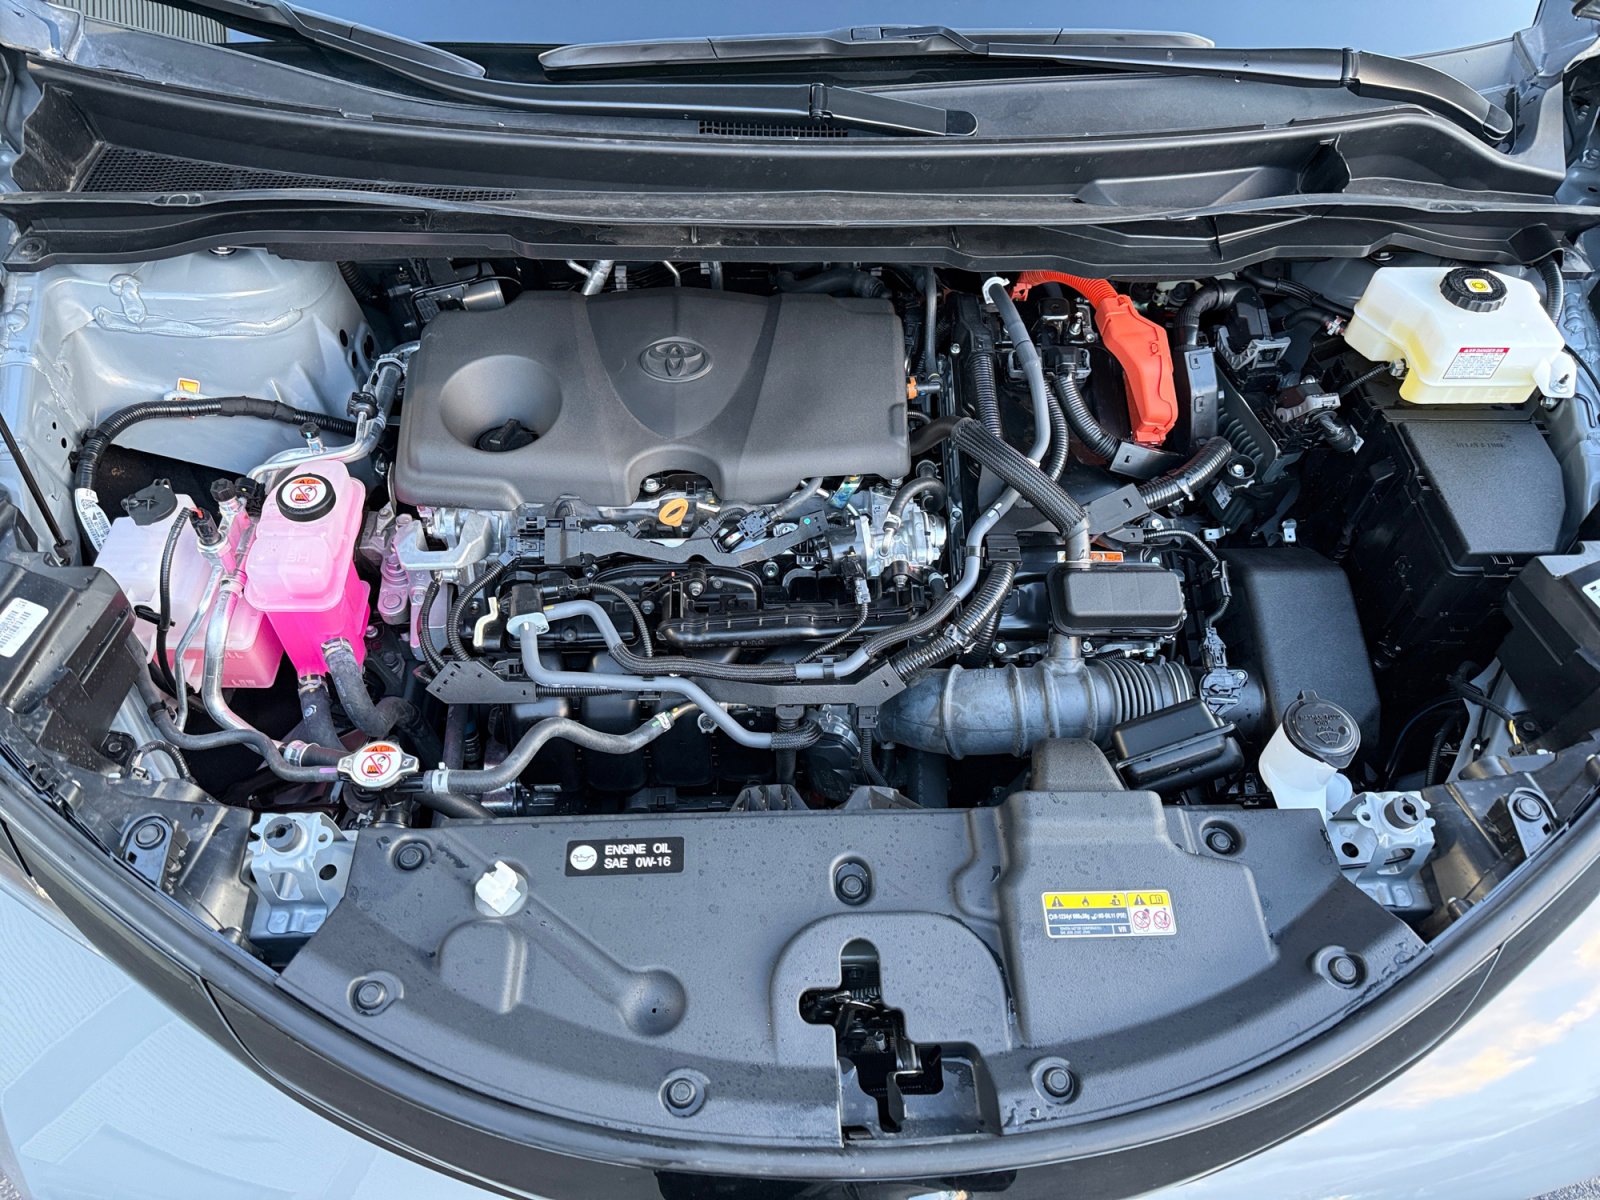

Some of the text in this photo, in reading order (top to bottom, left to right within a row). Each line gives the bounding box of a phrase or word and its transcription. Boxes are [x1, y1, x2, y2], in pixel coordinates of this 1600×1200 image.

[604, 843, 672, 855] ENGINE OIL
[603, 857, 671, 869] SAE 0W-16
